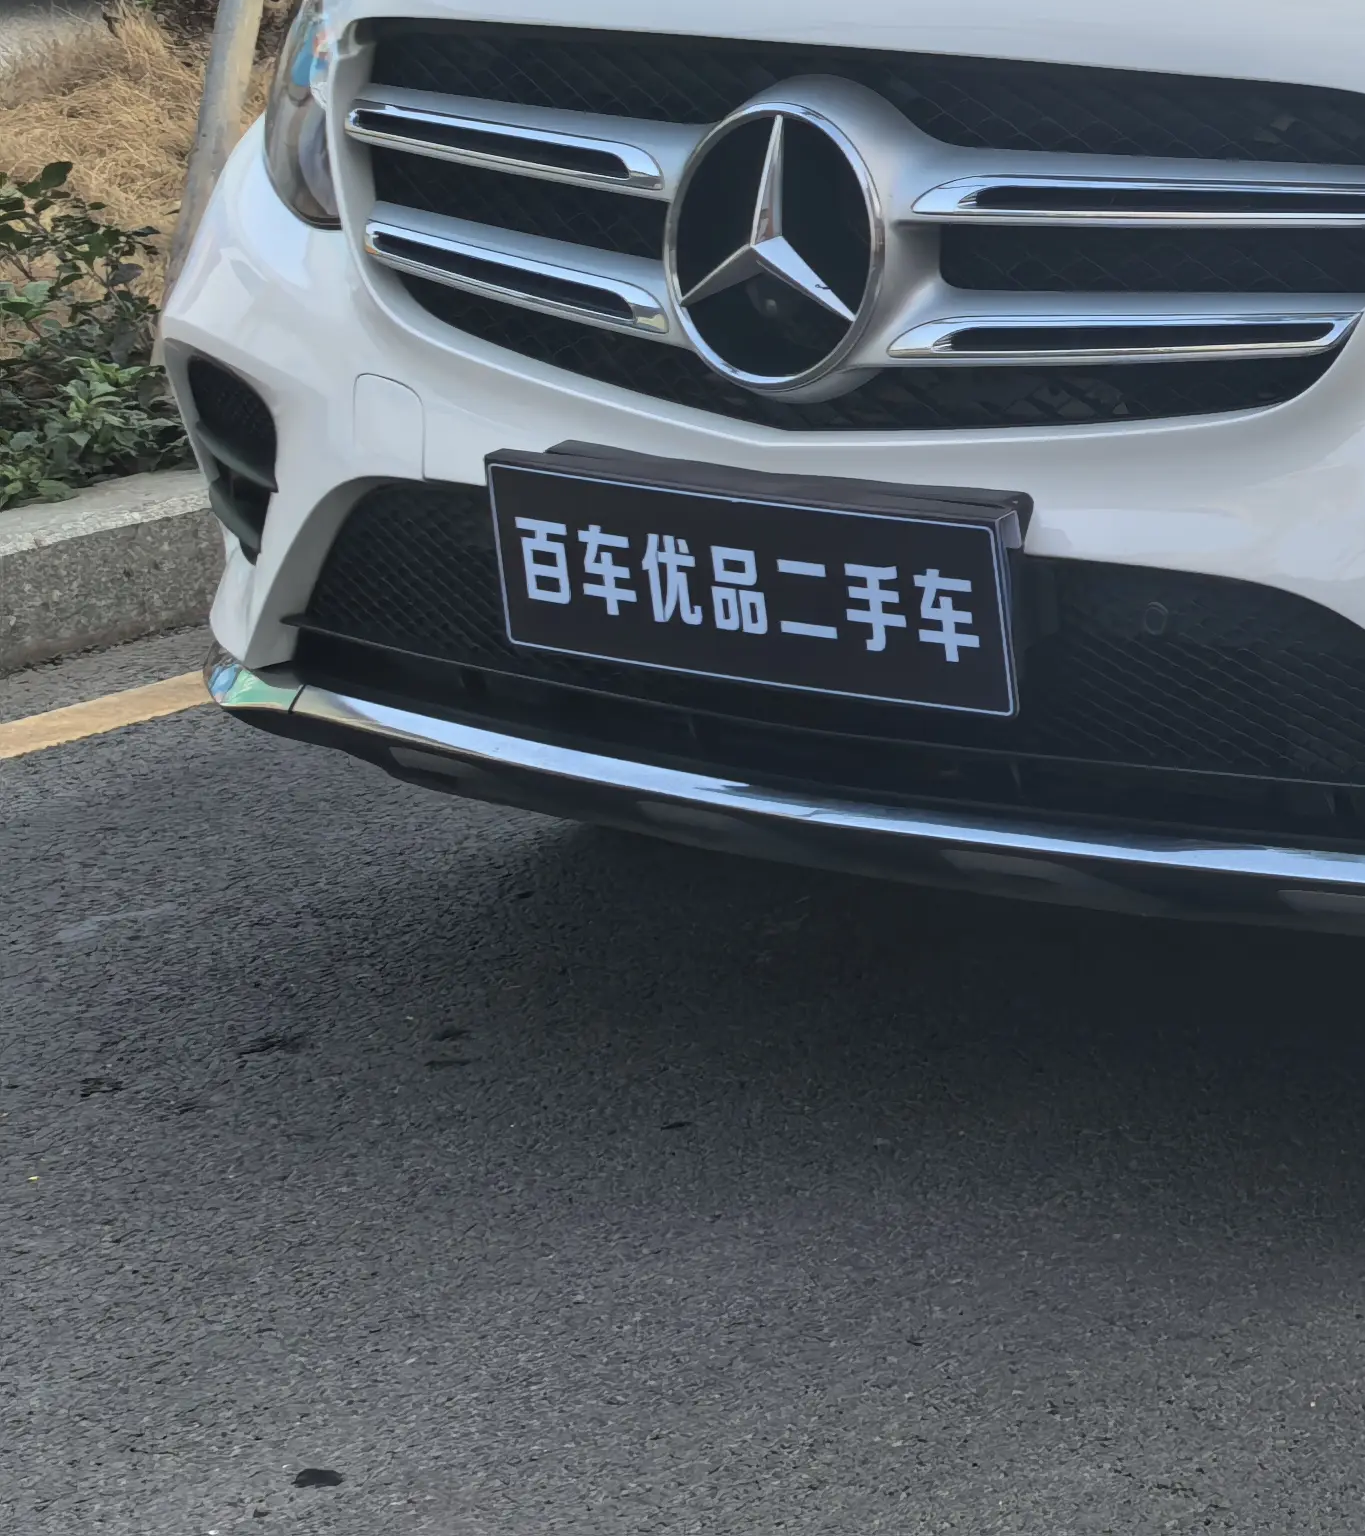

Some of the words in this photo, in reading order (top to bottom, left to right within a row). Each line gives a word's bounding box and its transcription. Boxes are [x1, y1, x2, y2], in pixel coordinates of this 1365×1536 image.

[514, 516, 981, 664] 百车优品二手车
